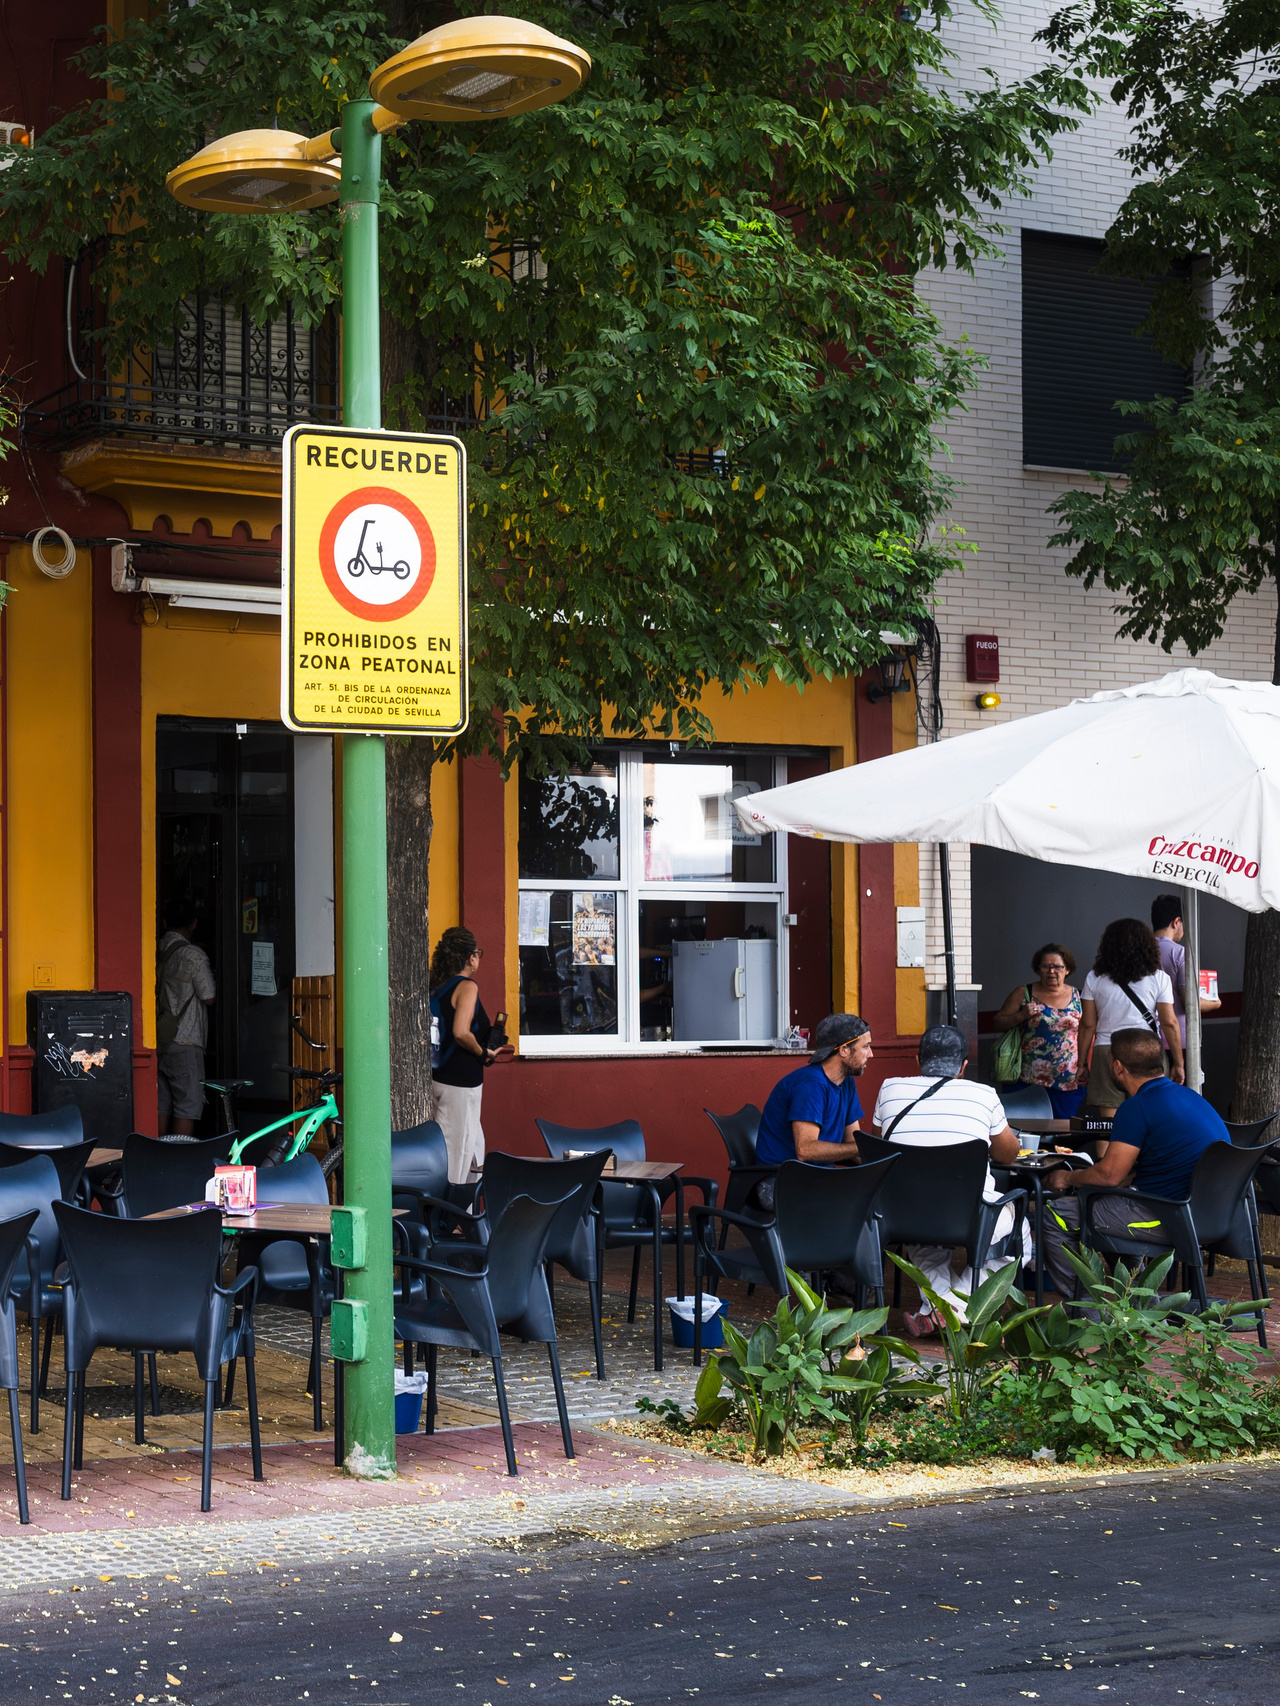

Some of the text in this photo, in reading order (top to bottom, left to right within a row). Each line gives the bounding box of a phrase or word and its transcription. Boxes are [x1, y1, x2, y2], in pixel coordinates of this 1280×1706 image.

[307, 444, 448, 475] RECUERDE
[304, 631, 451, 652] PROHIBIDOS EN
[976, 641, 998, 650] FUEGO
[299, 654, 456, 675] ZONA PEATONAL
[304, 682, 324, 691] ART.
[344, 684, 359, 692] BIS
[363, 684, 375, 693] DE
[380, 685, 391, 693] LA
[396, 686, 451, 695] ORDENANZA
[338, 694, 418, 705] DE CIRCULACIÓN
[314, 705, 441, 717] DE LA CIUDAD DE SEVILLA
[1086, 1121, 1113, 1130] BISTR
